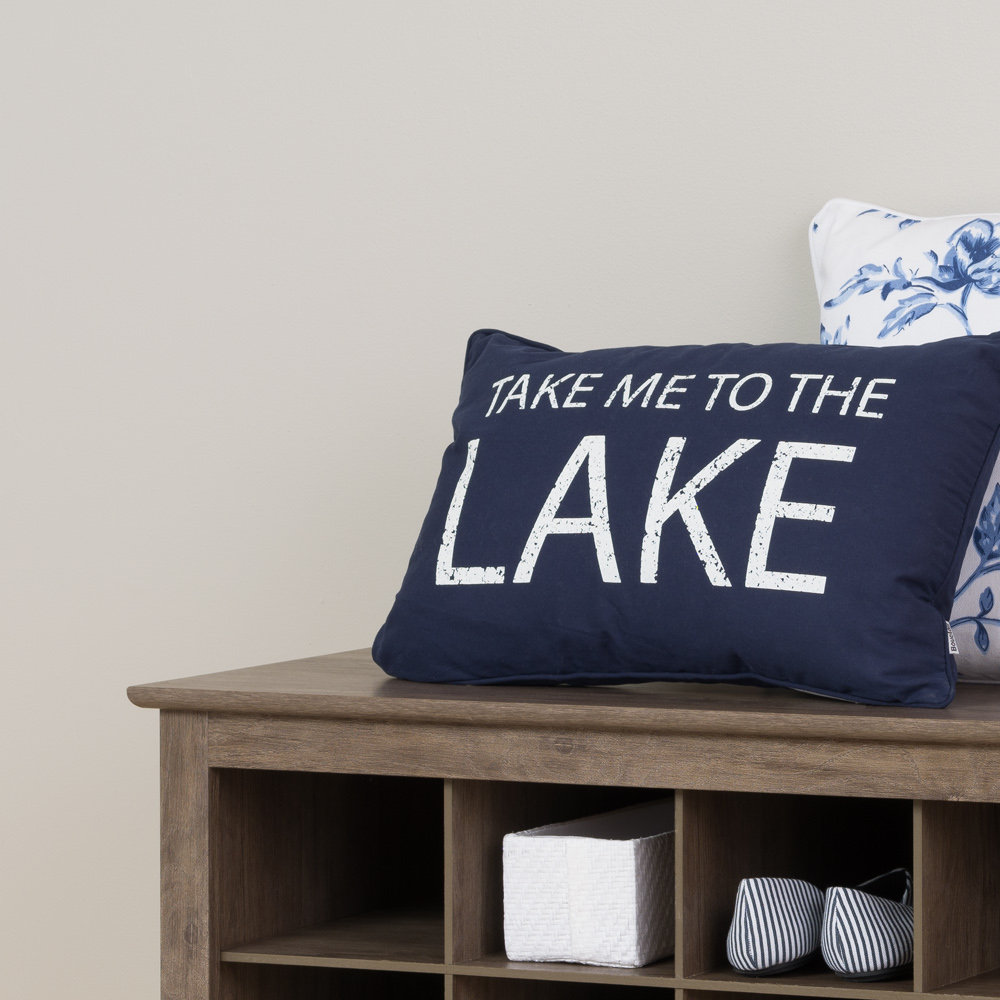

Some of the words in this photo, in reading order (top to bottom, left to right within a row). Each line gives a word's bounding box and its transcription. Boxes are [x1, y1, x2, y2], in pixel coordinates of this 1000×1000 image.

[485, 373, 604, 418] TAKE
[604, 373, 697, 409] ME
[705, 373, 773, 411] TO
[788, 374, 897, 419] THE
[436, 435, 857, 594] LAKE
